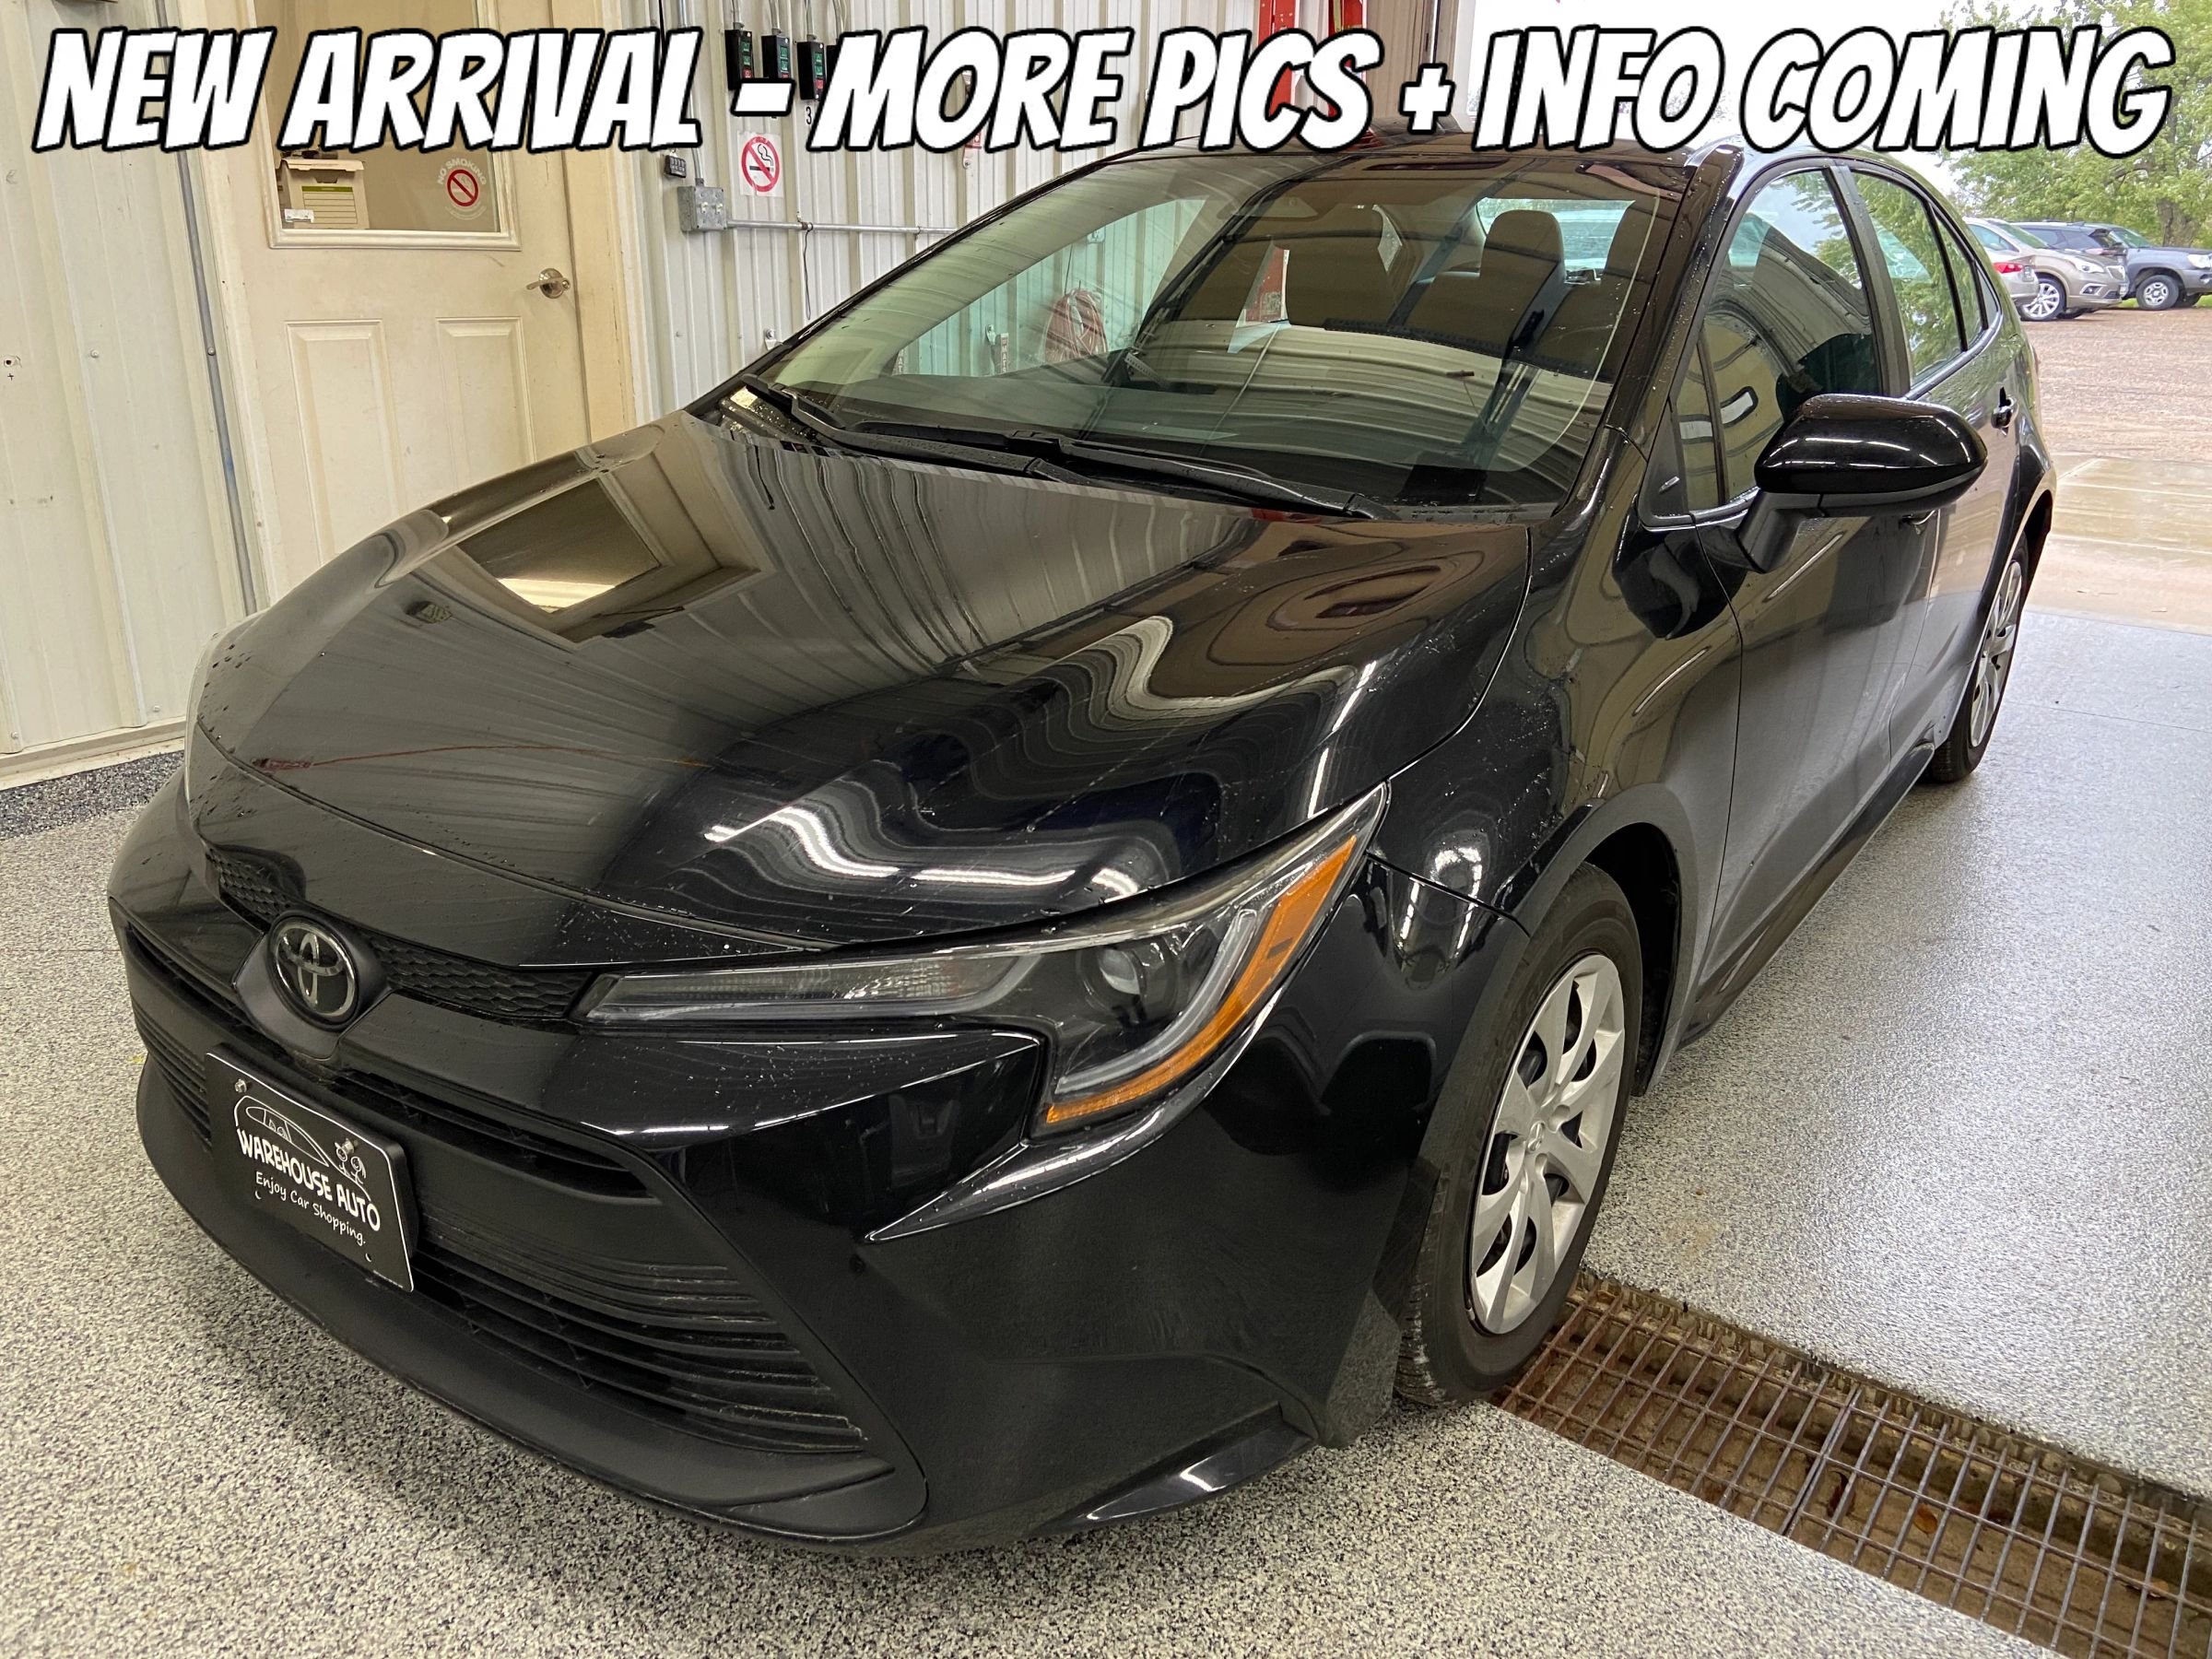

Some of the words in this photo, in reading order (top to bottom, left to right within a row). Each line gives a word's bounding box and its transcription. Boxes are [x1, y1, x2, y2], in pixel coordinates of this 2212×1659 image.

[806, 106, 812, 125] 3
[437, 168, 447, 184] NO
[446, 158, 487, 184] SMOKING
[236, 1128, 333, 1202] WAREHOUSE
[335, 1183, 381, 1231] AUTO
[255, 1171, 287, 1201] Enjoy
[289, 1191, 310, 1208] Car
[312, 1203, 366, 1246] Shopping.
